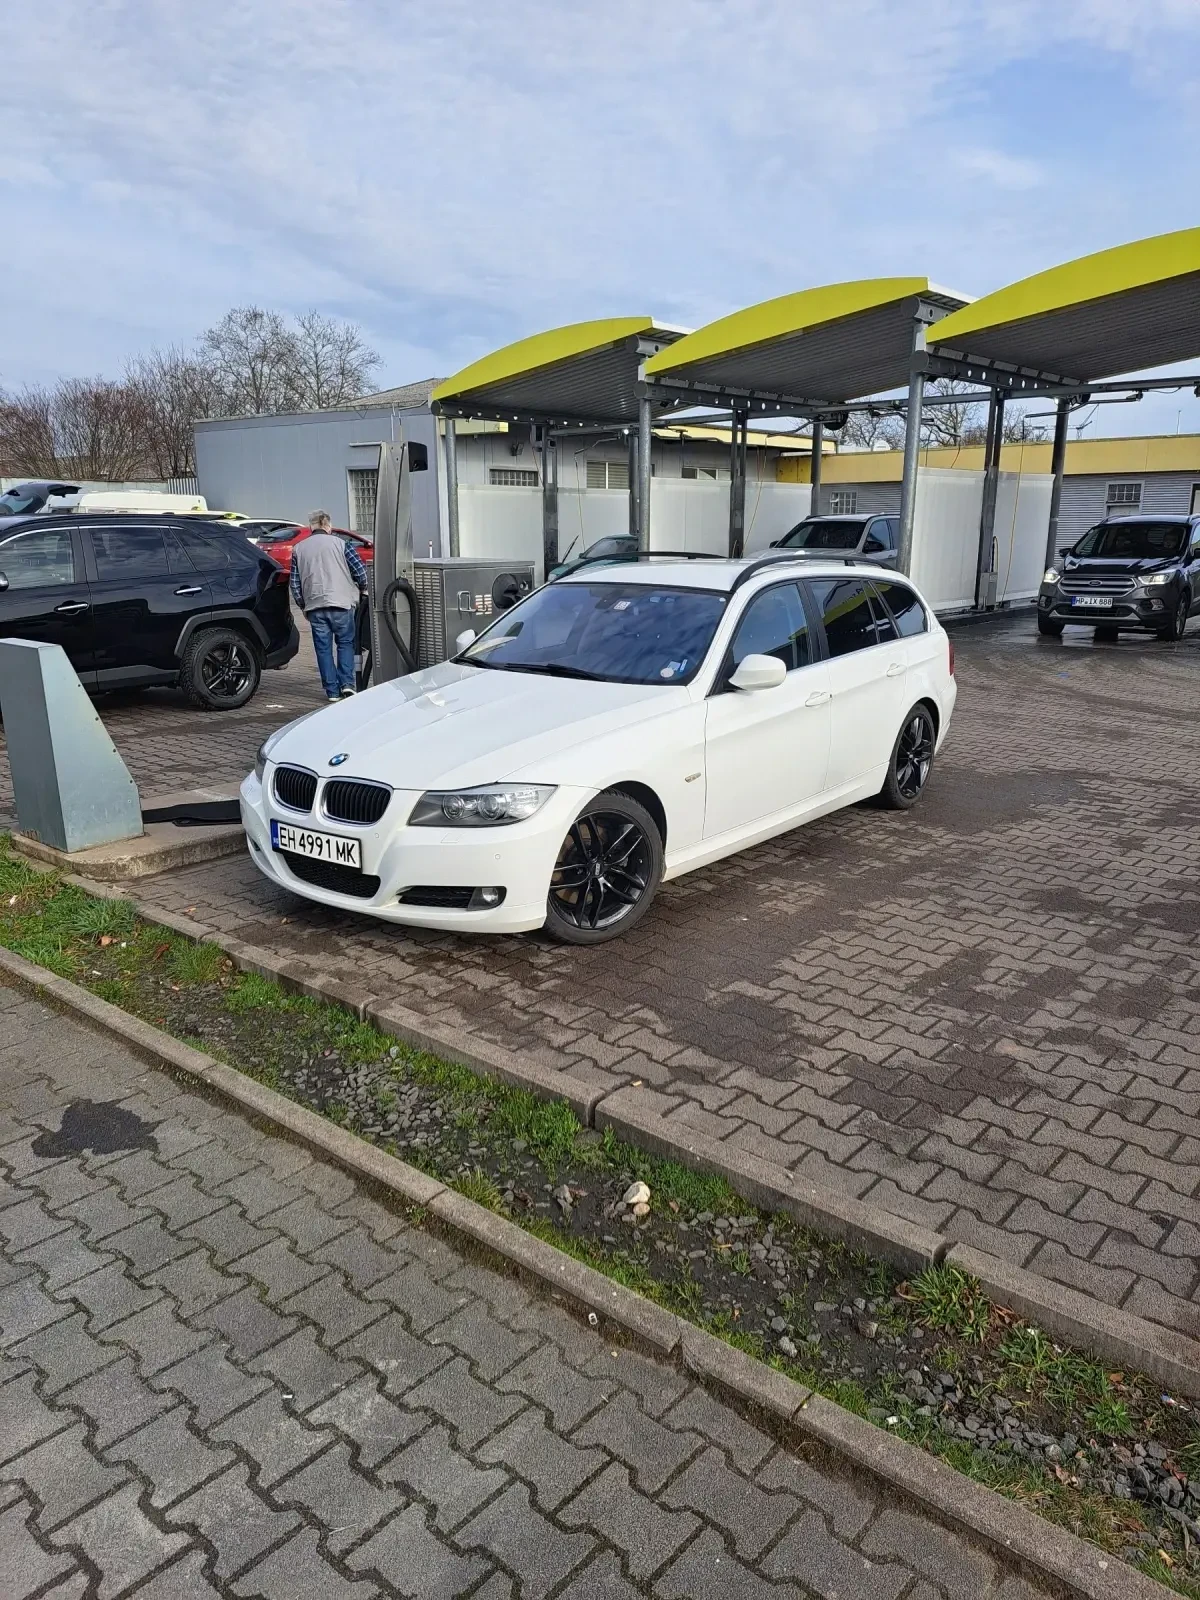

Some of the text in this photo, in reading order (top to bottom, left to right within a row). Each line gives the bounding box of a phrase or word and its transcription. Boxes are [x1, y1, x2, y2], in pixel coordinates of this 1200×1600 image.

[279, 826, 357, 864] EH 4991 MK
